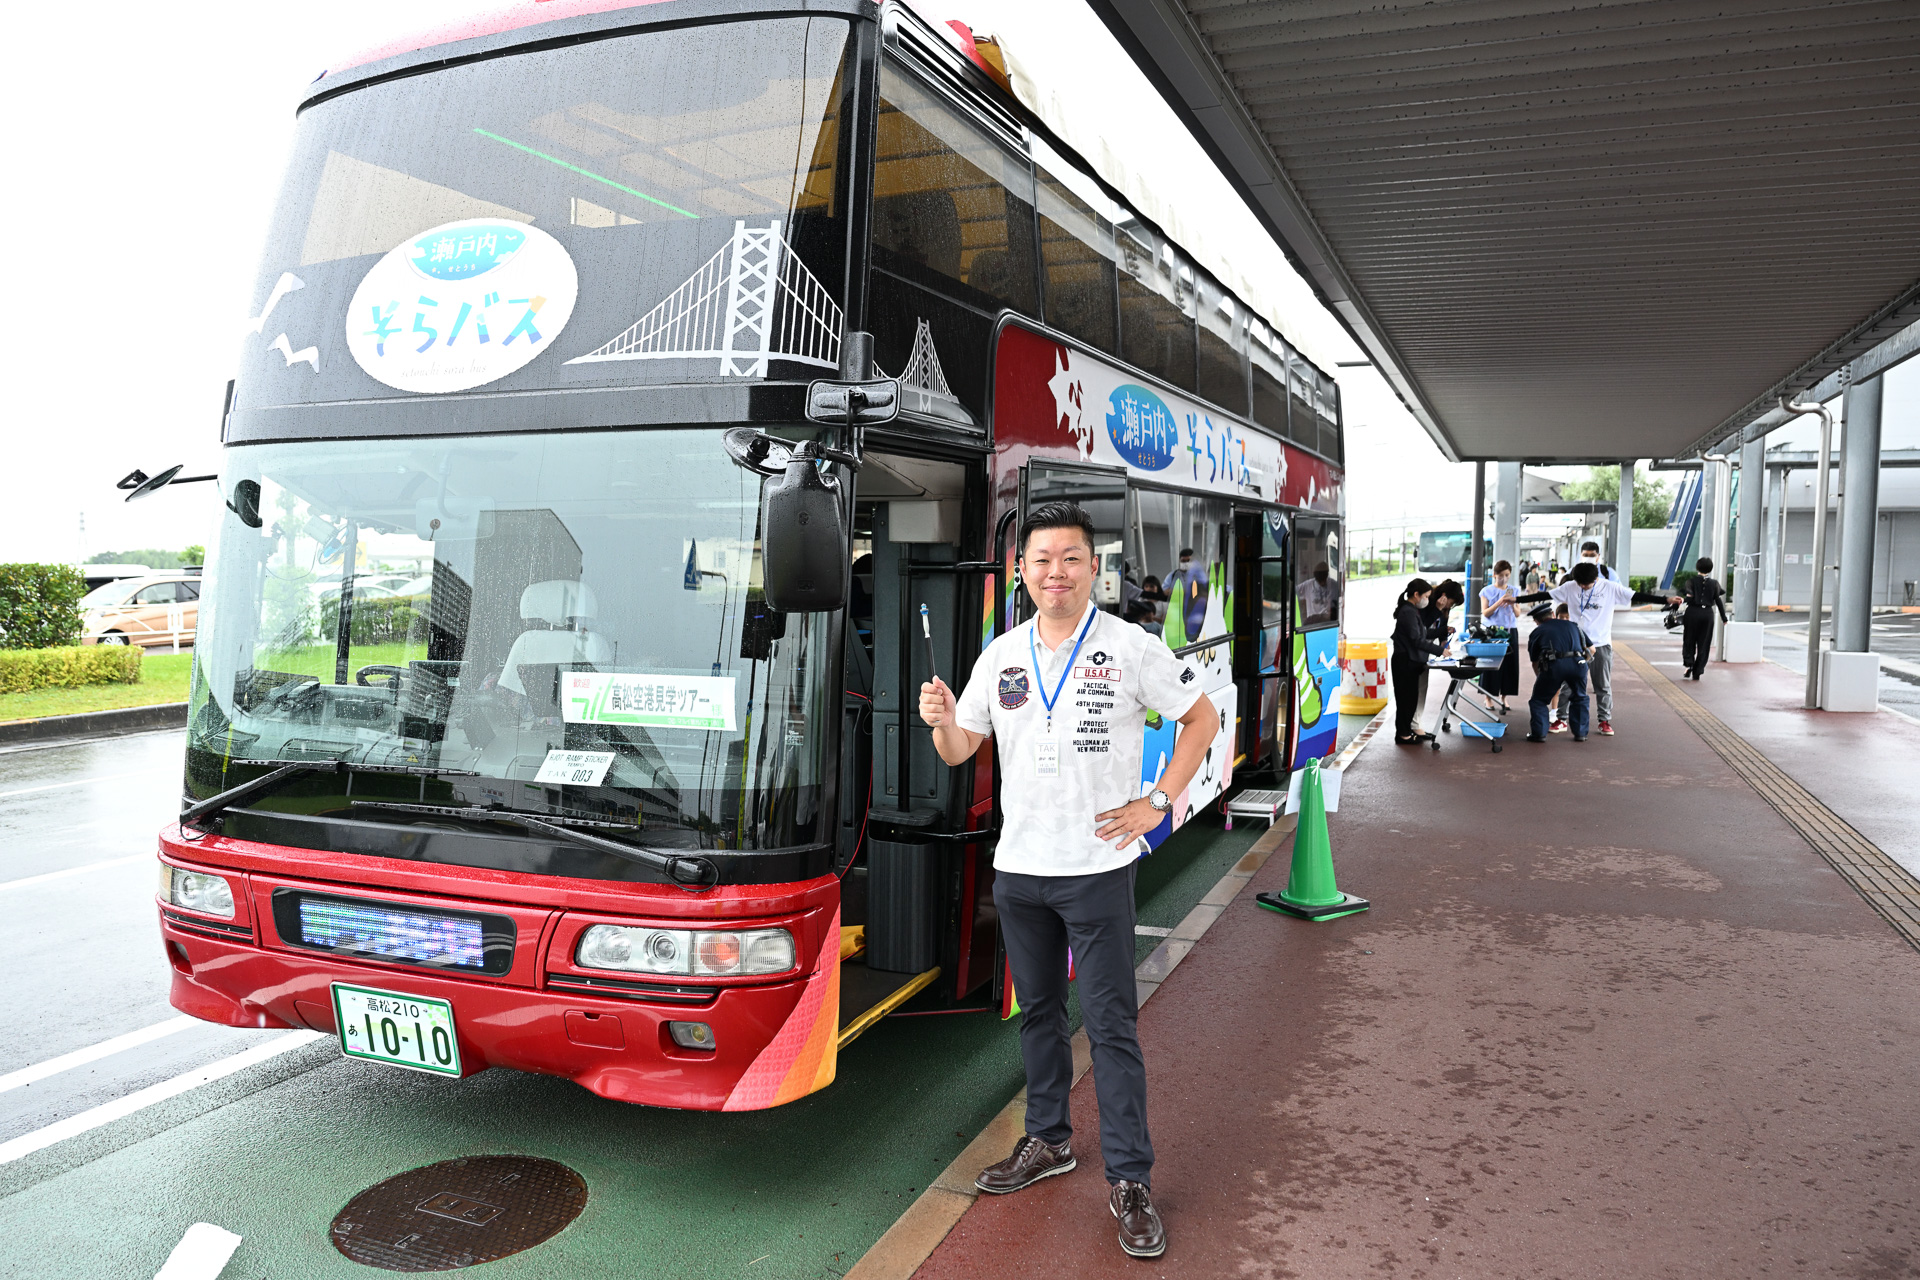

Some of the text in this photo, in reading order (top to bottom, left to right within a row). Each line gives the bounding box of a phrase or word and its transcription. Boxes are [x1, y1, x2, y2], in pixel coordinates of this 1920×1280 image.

[430, 232, 498, 263] 瀬戸内
[448, 263, 476, 273] せとうち
[362, 291, 547, 357] そらバス
[469, 358, 487, 374] bus
[1120, 391, 1167, 456] 瀬戸内
[1186, 411, 1251, 486] そらバス
[1138, 453, 1156, 468] せとうち
[1084, 668, 1111, 679] U.S.A.F.
[1083, 682, 1110, 690] TACTICAL
[1087, 689, 1115, 697] COMMAND
[611, 683, 710, 713] 高松空港見学ツアー
[1091, 701, 1114, 709] FIGHTER
[1083, 720, 1108, 728] PROTECT
[1038, 744, 1056, 753] TAK
[565, 754, 584, 762] RAMP
[585, 755, 609, 764] STICKER
[547, 769, 594, 783] TAK 003
[348, 1013, 452, 1066] あ 10-10
